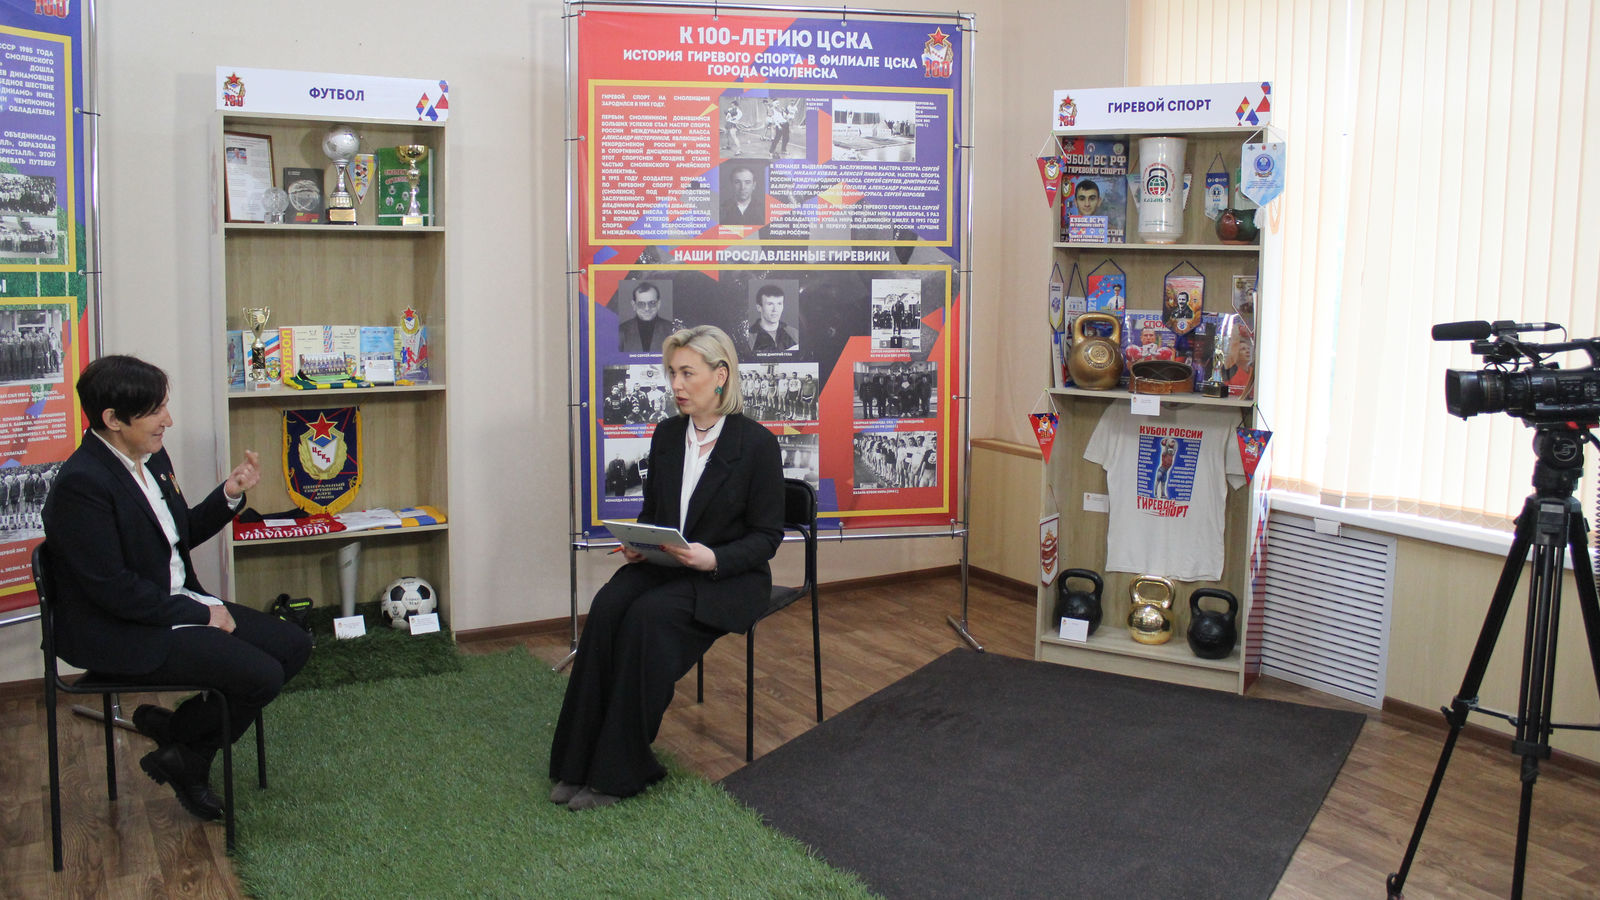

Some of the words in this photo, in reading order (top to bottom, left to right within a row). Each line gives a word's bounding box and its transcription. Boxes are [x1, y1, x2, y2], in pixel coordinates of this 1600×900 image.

[680, 26, 693, 45] К
[697, 27, 812, 48] 100-ЛЕТИЮ
[817, 31, 873, 52] ЦСКА
[6, 53, 54, 65] СМОЛЕНСКОГО
[623, 49, 683, 62] ИСТОРИЯ
[688, 51, 750, 64] ГИРЕВОГО
[754, 53, 803, 66] СПОРТА
[808, 54, 816, 66] В
[820, 55, 880, 68] ФИЛИАЛЕ
[885, 57, 918, 70] ЦСКА
[30, 65, 54, 74] ДОШЛА
[707, 64, 758, 78] ГОРОДА
[760, 65, 838, 80] СМОЛЕНСКА
[925, 60, 951, 78] 100
[10, 71, 55, 82] ДИНАМОВЦЕВ
[25, 81, 55, 91] ШЕСТВИЕ
[309, 87, 364, 102] ФУТБОЛ
[14, 97, 55, 108] ЧЕМПИОНОМ
[1107, 97, 1165, 113] ГИРЕВОЙ
[1167, 99, 1212, 112] СПОРТ
[9, 105, 55, 116] ОБЛАДАТЕЛЕМ
[4, 131, 56, 142] ОБЪЕДИНИЛАСЬ
[18, 141, 55, 150] ОБРАЗОВАВ
[1094, 155, 1107, 165] ВС
[1110, 156, 1126, 167] РФ
[1068, 166, 1099, 174] ГИРЕВОМУ
[674, 249, 713, 262] НАШИ
[716, 249, 827, 262] ПРОСЛАВЛЕННЫЕ
[829, 250, 890, 262] ГИРЕВИКИ
[1139, 425, 1168, 437] КУБОК
[1168, 428, 1203, 440] РОССИИ
[311, 446, 331, 464] ЦСКА
[1158, 504, 1190, 518] СПОРТ
